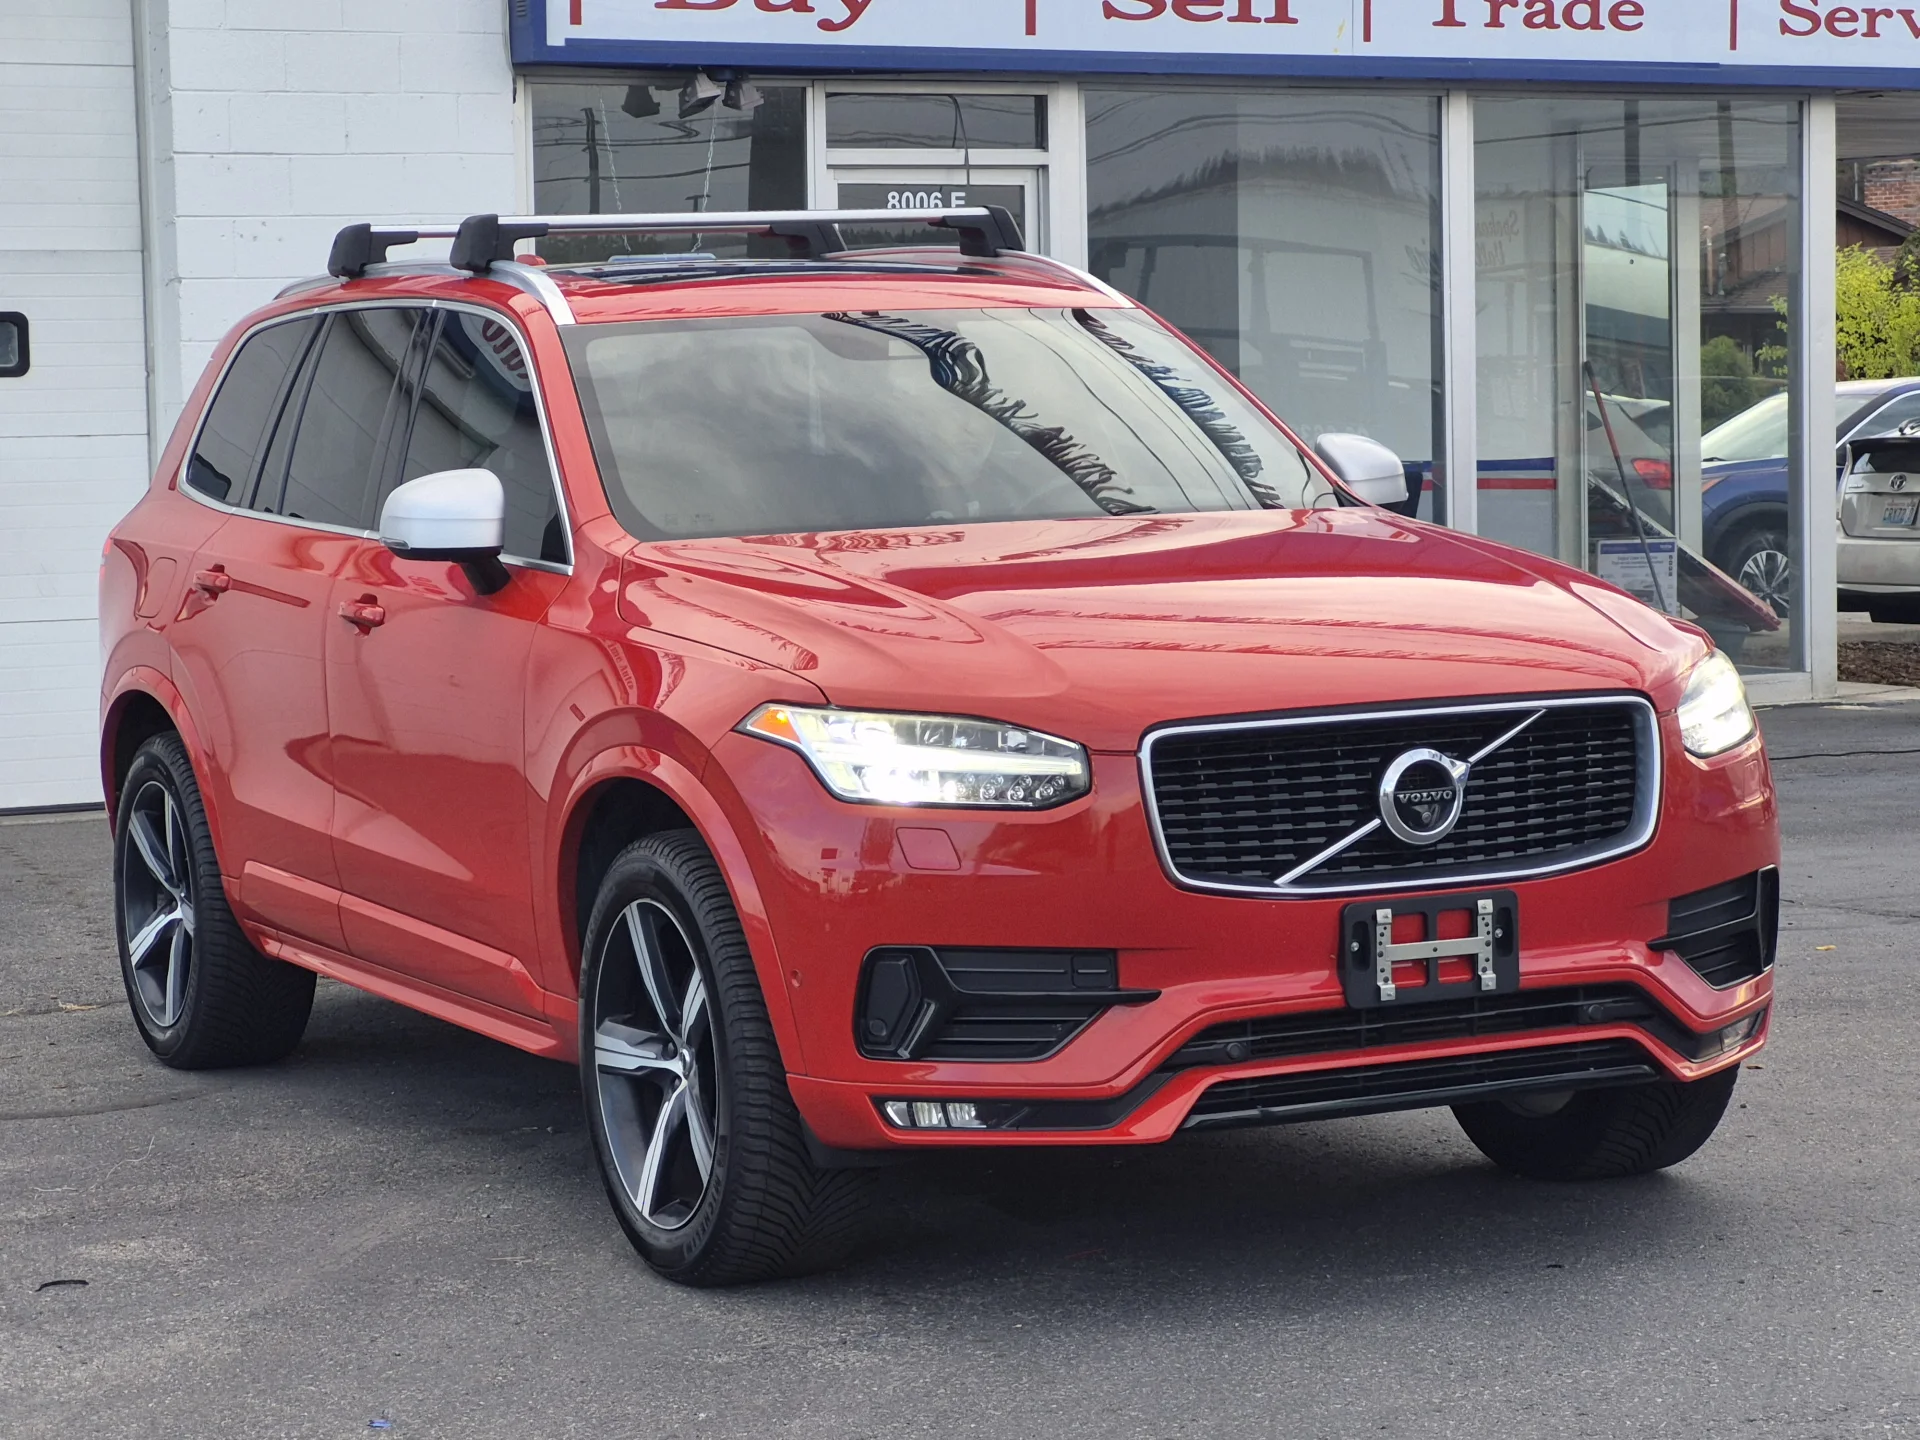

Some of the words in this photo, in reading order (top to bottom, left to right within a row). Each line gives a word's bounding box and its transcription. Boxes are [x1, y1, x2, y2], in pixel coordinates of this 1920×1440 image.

[887, 191, 943, 209] 8006
[1397, 790, 1453, 804] VOLVO
[684, 1175, 722, 1257] MICHELIN
